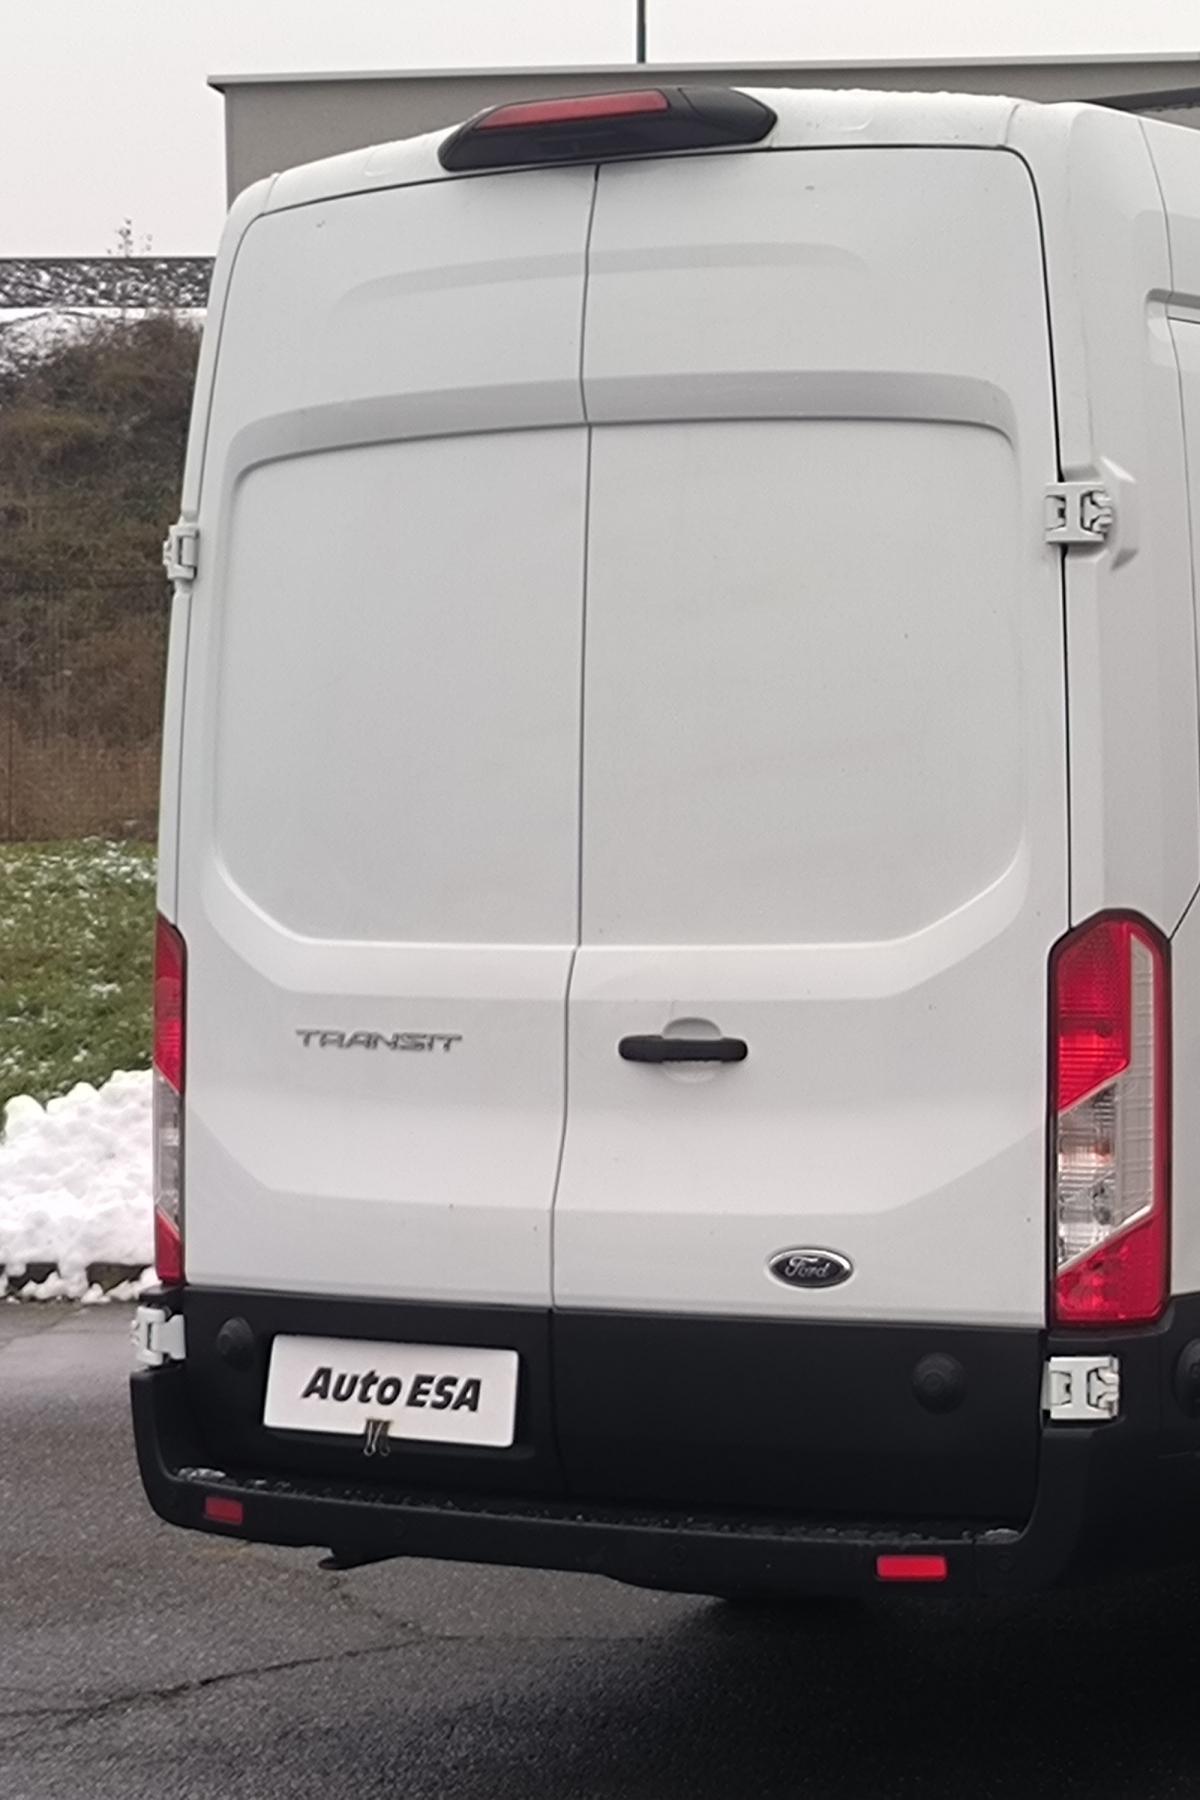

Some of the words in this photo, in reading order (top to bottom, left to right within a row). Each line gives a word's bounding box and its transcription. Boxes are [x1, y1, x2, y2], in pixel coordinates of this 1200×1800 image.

[296, 1029, 463, 1051] TRANSIT
[785, 1256, 831, 1277] Ford
[301, 1367, 403, 1406] Auto
[405, 1374, 482, 1412] ESA
